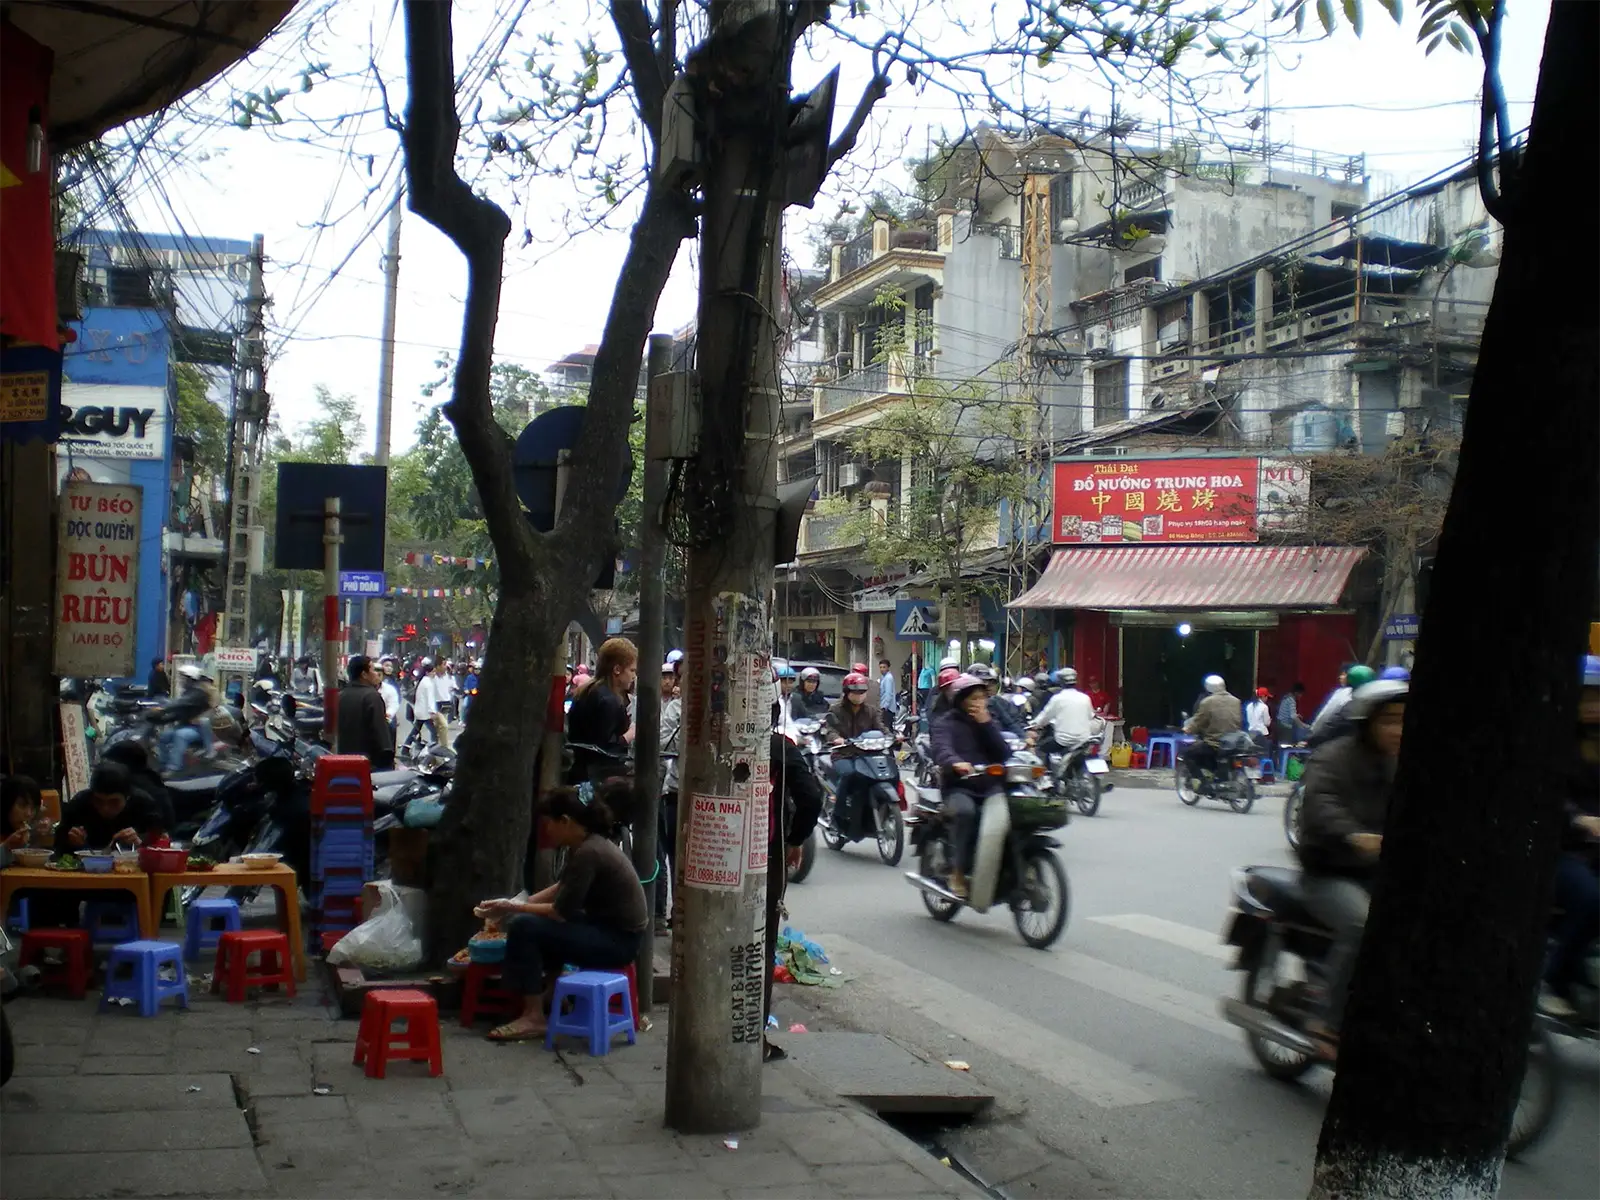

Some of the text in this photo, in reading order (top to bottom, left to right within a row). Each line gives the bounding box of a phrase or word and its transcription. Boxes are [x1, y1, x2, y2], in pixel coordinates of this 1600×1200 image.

[1094, 463, 1138, 476] Thái Đạt
[1073, 473, 1244, 491] ĐỒ NƯỚNG TRUNG HOA
[97, 493, 134, 514] BÉO
[1091, 488, 1219, 514] 中國燒烤
[67, 545, 131, 584] BÚN
[61, 587, 133, 626] RIÊU
[103, 632, 123, 648] BỘ
[719, 801, 742, 815] NHÀ
